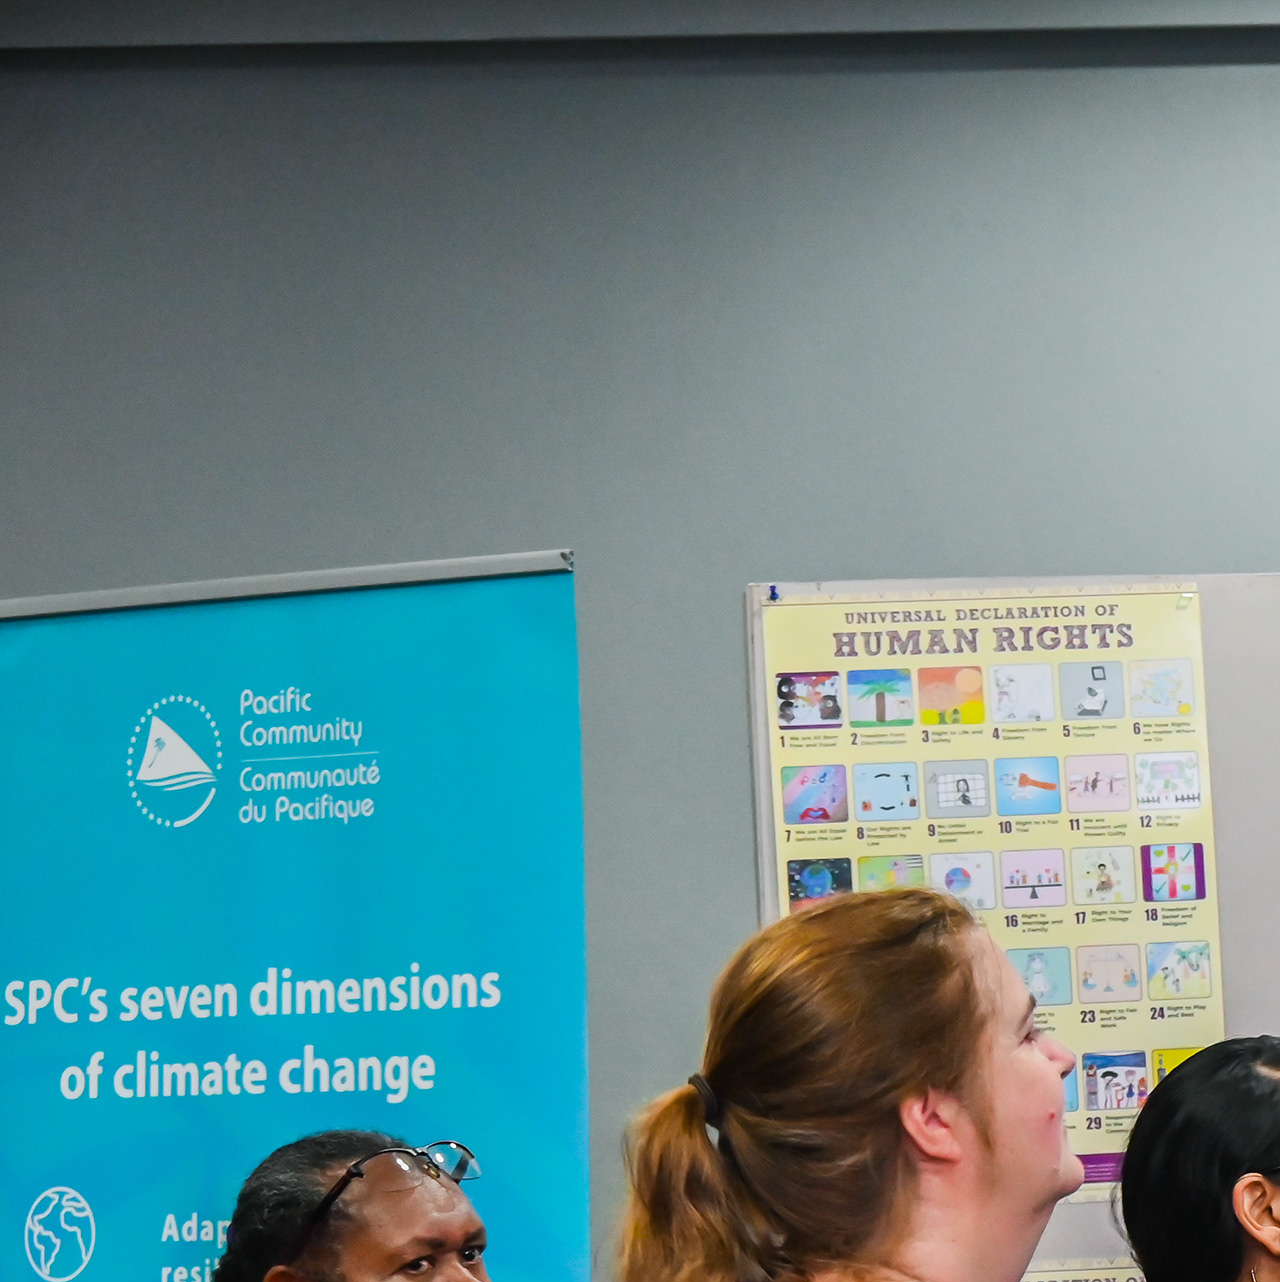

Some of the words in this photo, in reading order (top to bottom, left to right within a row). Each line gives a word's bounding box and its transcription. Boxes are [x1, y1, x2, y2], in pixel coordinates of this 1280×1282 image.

[845, 610, 946, 624] UNIVERSAL
[955, 606, 1085, 621] DECLARATION
[1095, 605, 1118, 616] OF
[832, 628, 978, 657] HUMAN
[993, 623, 1133, 652] RIGHTS
[240, 687, 311, 715] Pacific
[240, 718, 362, 746] Community
[993, 728, 1000, 739] 4
[1063, 725, 1070, 737] 5
[1133, 722, 1140, 734] 6
[780, 736, 785, 747] 1
[851, 733, 857, 745] 2
[922, 730, 929, 742] 3
[240, 757, 380, 791] Communauté
[239, 799, 266, 823] du
[276, 794, 374, 824] Pacifique
[999, 821, 1012, 833] 10
[1069, 819, 1080, 830] 11
[1140, 815, 1152, 828] 12
[785, 830, 791, 842] 7
[857, 827, 864, 839] 8
[928, 824, 935, 836] 9
[1005, 915, 1018, 927] 16
[1075, 912, 1086, 924] 17
[1145, 909, 1158, 921] 18
[120, 983, 237, 1021] seven
[250, 963, 501, 1016] dimensions
[1080, 1010, 1095, 1023] 23
[1151, 1007, 1165, 1019] 24
[61, 1052, 104, 1099] of
[114, 1051, 267, 1098] climate
[279, 1045, 435, 1103] change
[1086, 1117, 1101, 1130] 29
